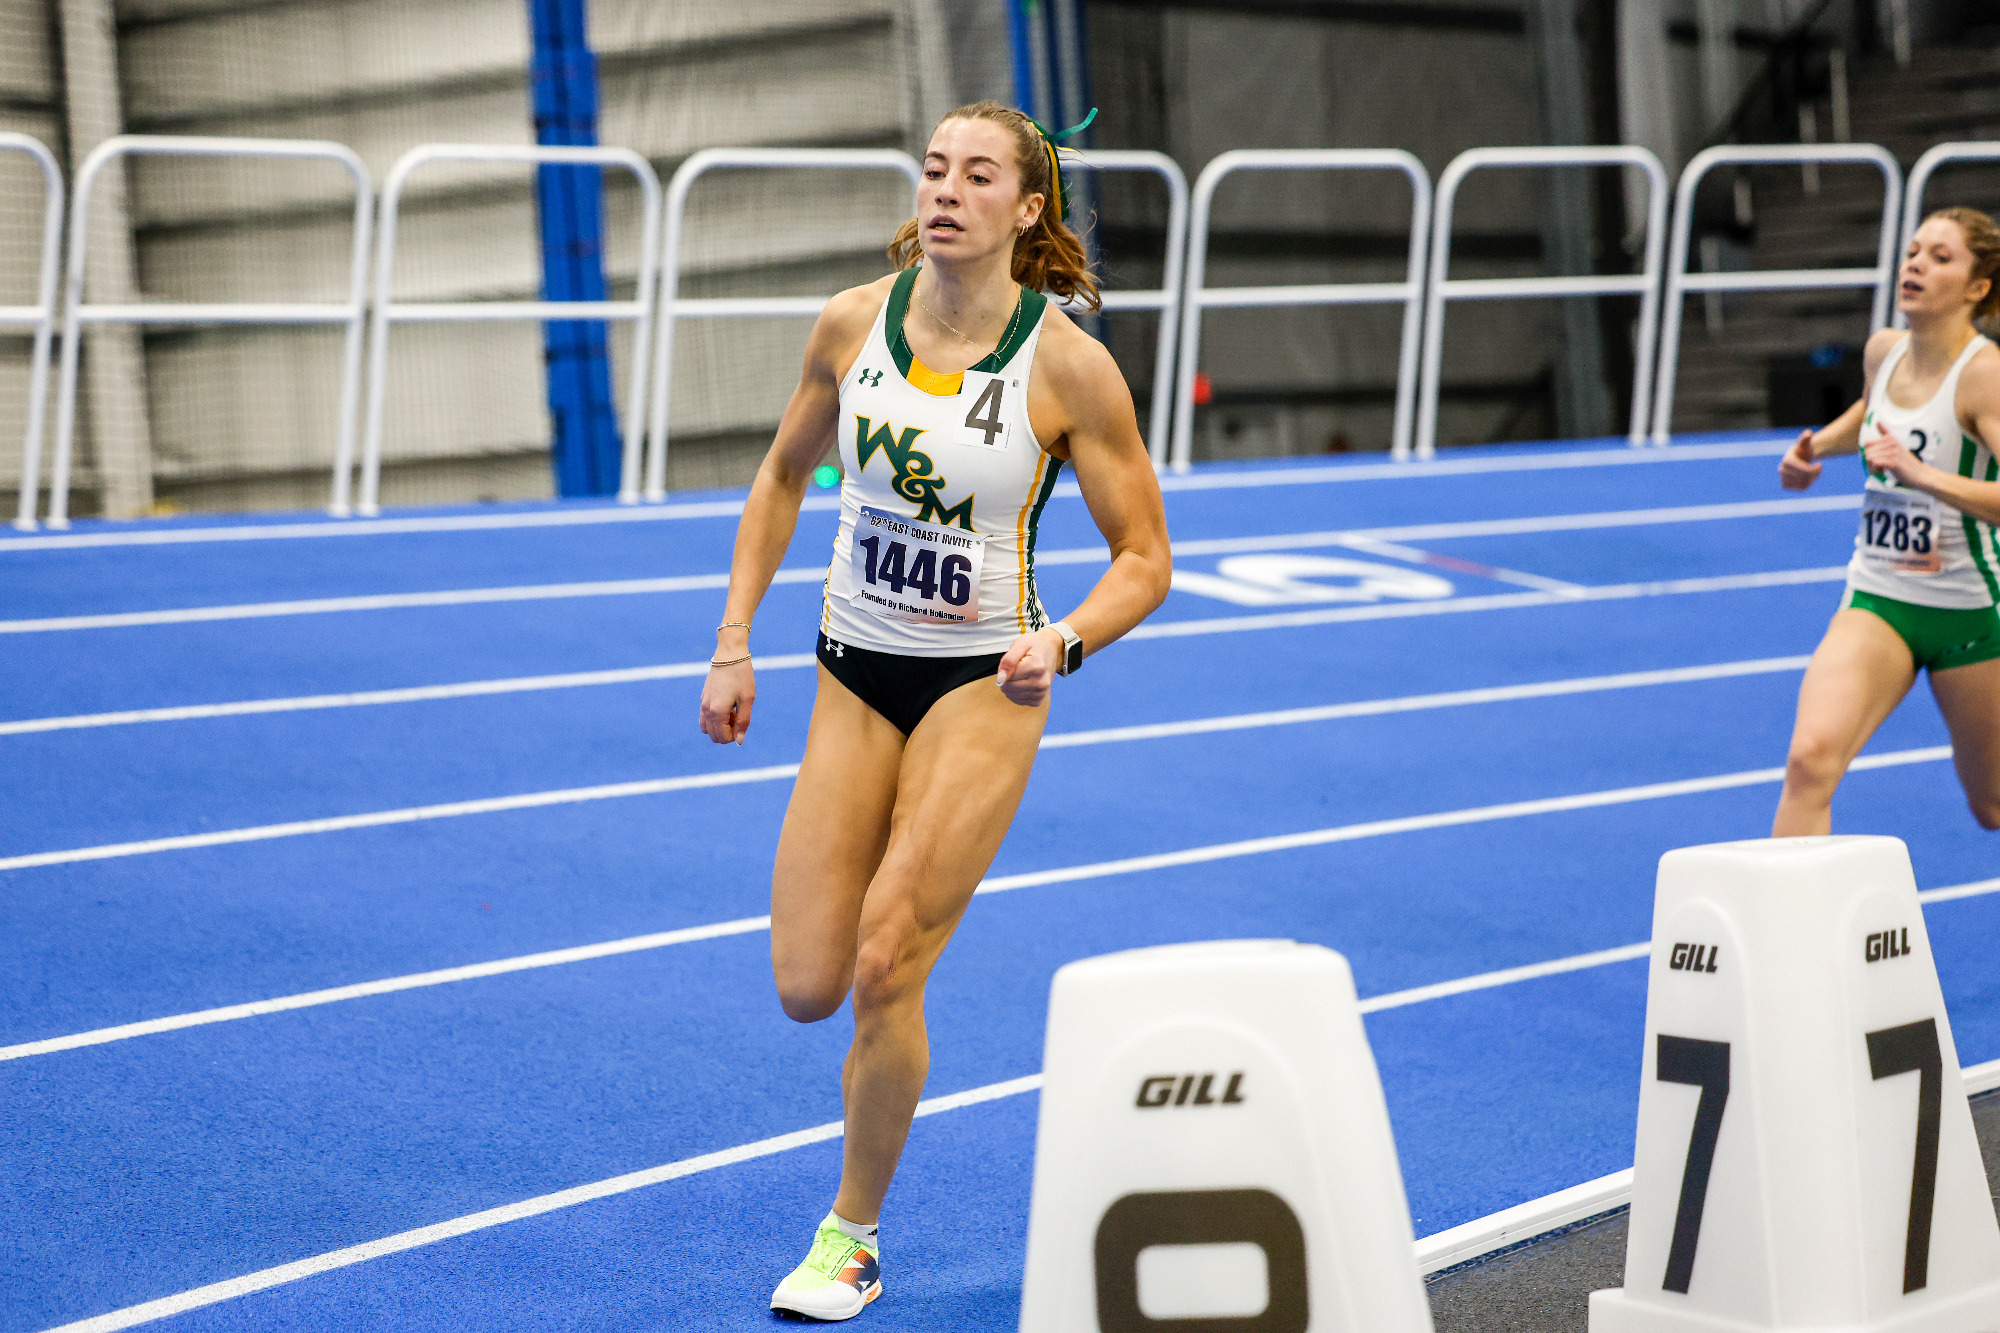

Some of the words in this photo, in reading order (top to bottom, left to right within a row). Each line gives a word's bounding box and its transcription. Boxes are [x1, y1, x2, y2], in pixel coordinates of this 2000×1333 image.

[965, 378, 1005, 446] 4
[887, 520, 910, 536] EAST
[911, 527, 940, 543] COAST
[941, 533, 973, 549] INVITE
[1864, 509, 1933, 555] 1283
[859, 535, 972, 606] 1446
[861, 590, 887, 606] Founded
[887, 600, 897, 610] By
[898, 603, 928, 616] Richard
[929, 609, 966, 621] Hollander
[1669, 942, 1719, 973] GILL
[1863, 927, 1911, 963] GILL
[1135, 1071, 1246, 1108] GILL
[1656, 1034, 1731, 1295] 7
[1865, 1018, 1943, 1295] 7
